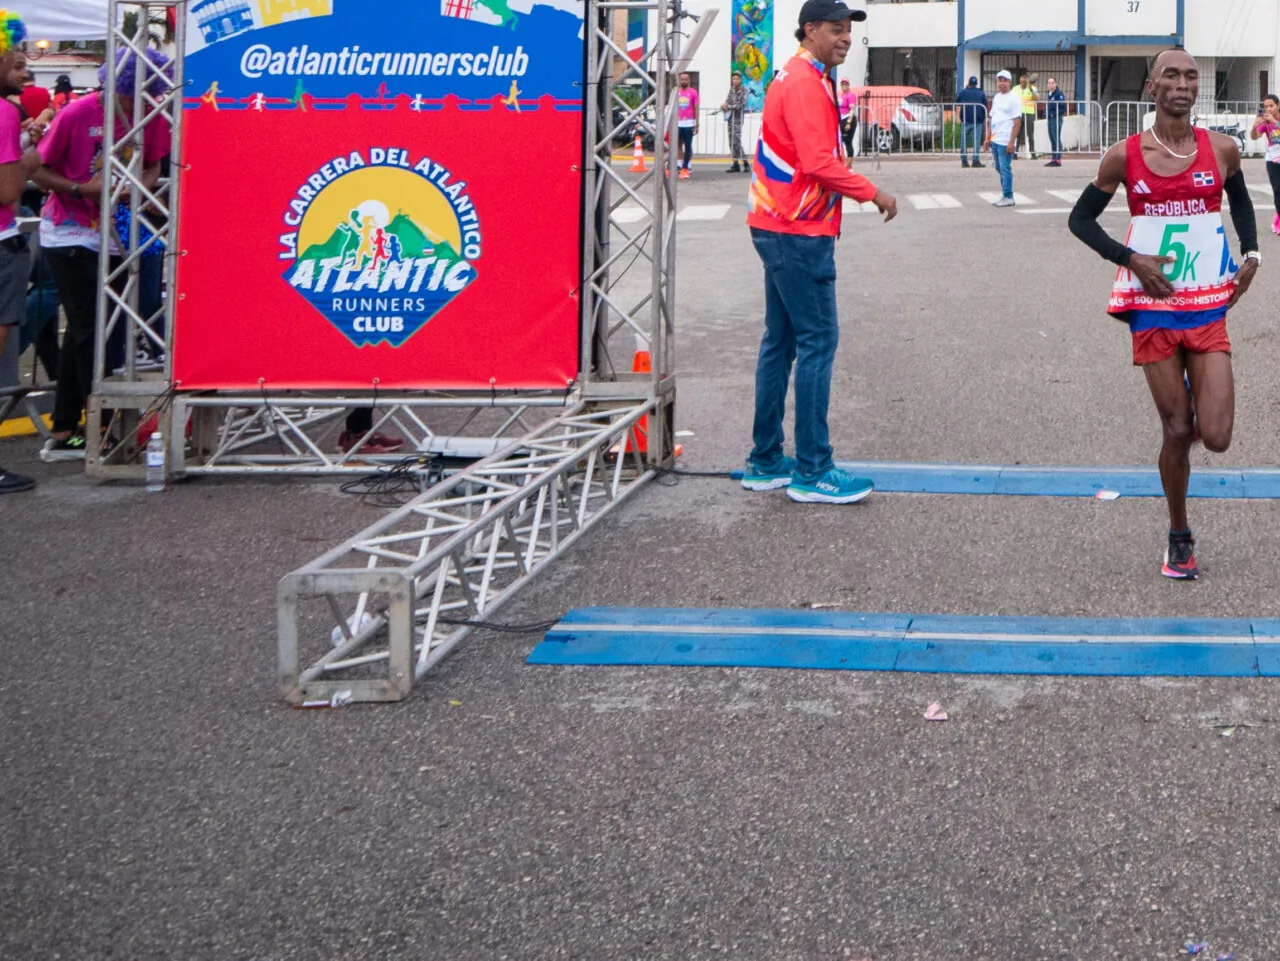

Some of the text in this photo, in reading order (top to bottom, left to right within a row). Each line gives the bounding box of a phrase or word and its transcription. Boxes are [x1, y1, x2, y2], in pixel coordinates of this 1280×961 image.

[1127, 0, 1140, 13] 37
[240, 43, 529, 78] @atlanticrunnersclub
[279, 148, 481, 260] LA CARRERA DEL ATLÁNTICO
[1144, 198, 1207, 216] REPÚBLICA
[289, 257, 472, 293] ATLANTIC
[332, 298, 425, 312] RUNNERS
[353, 316, 404, 332] CLUB
